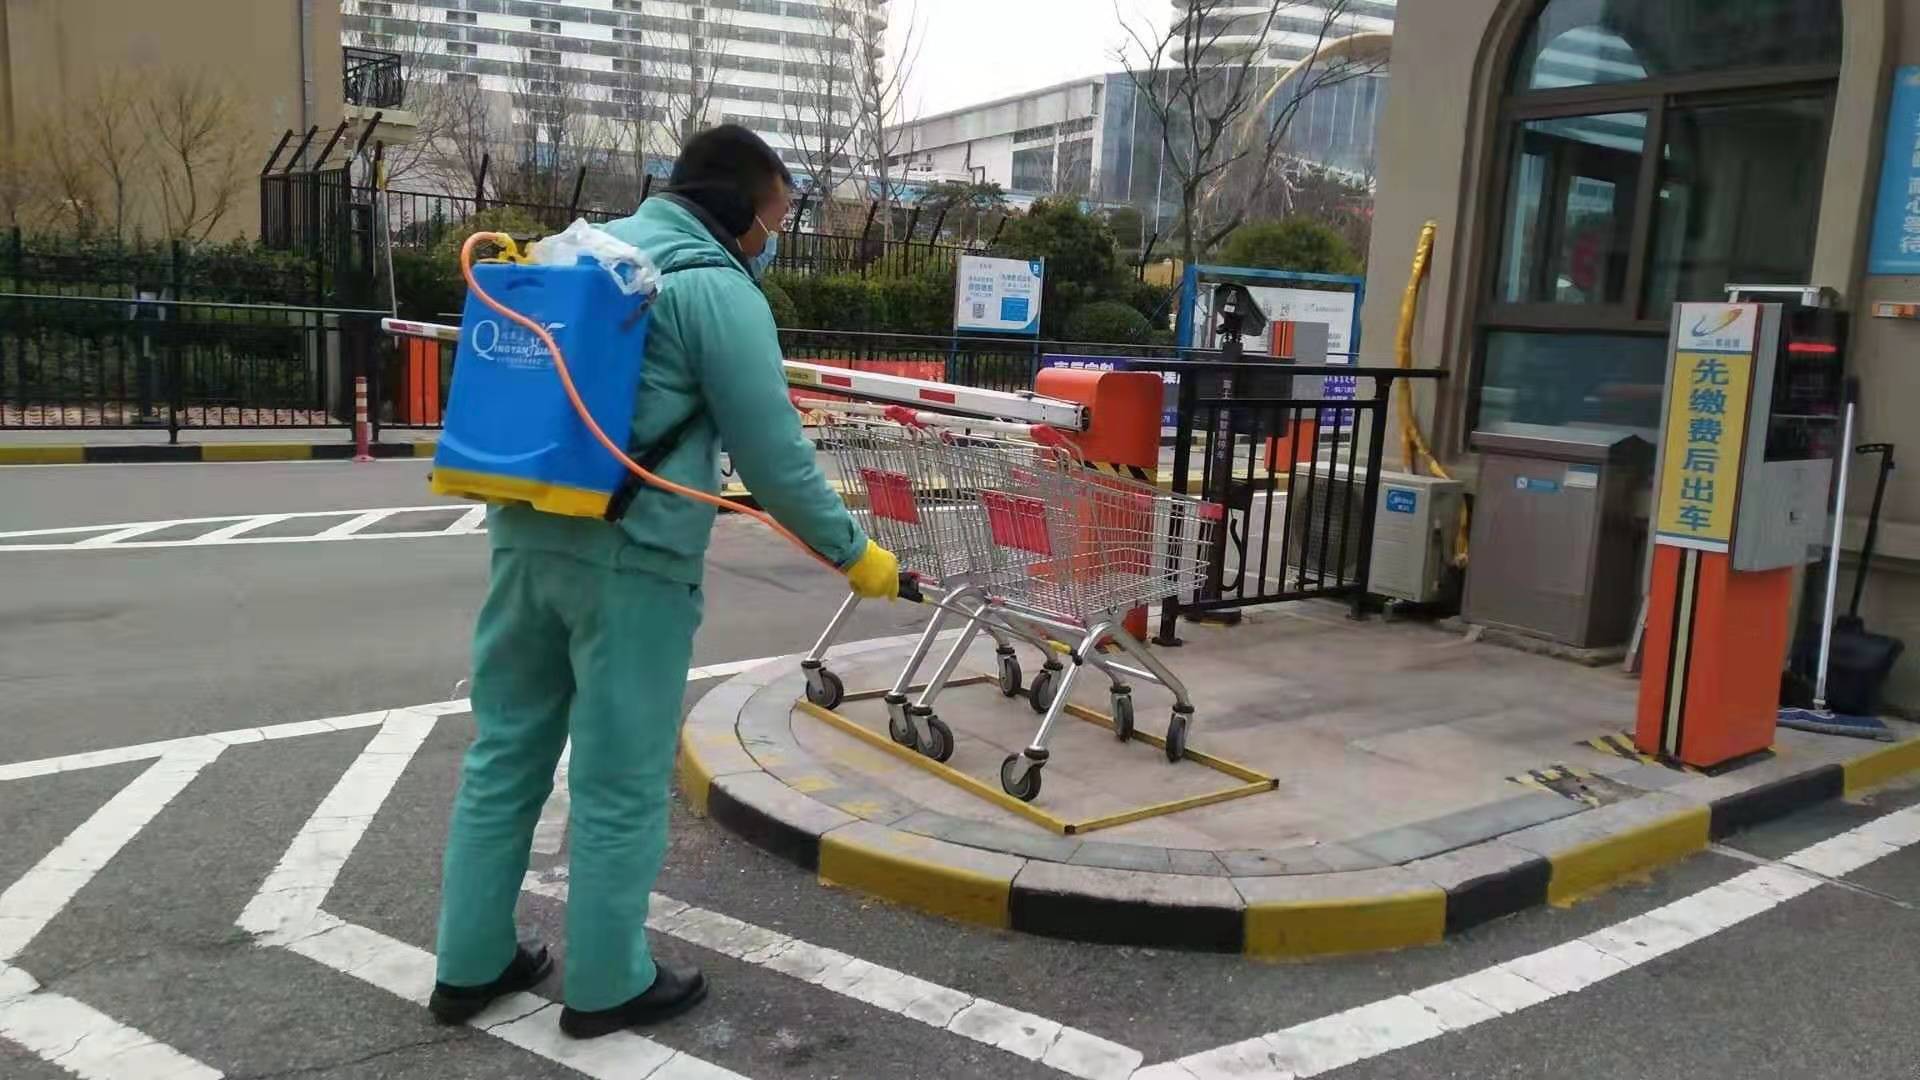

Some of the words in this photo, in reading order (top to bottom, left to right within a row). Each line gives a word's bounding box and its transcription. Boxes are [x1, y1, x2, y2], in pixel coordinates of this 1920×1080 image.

[1675, 358, 1729, 531] 先缴费后出车
